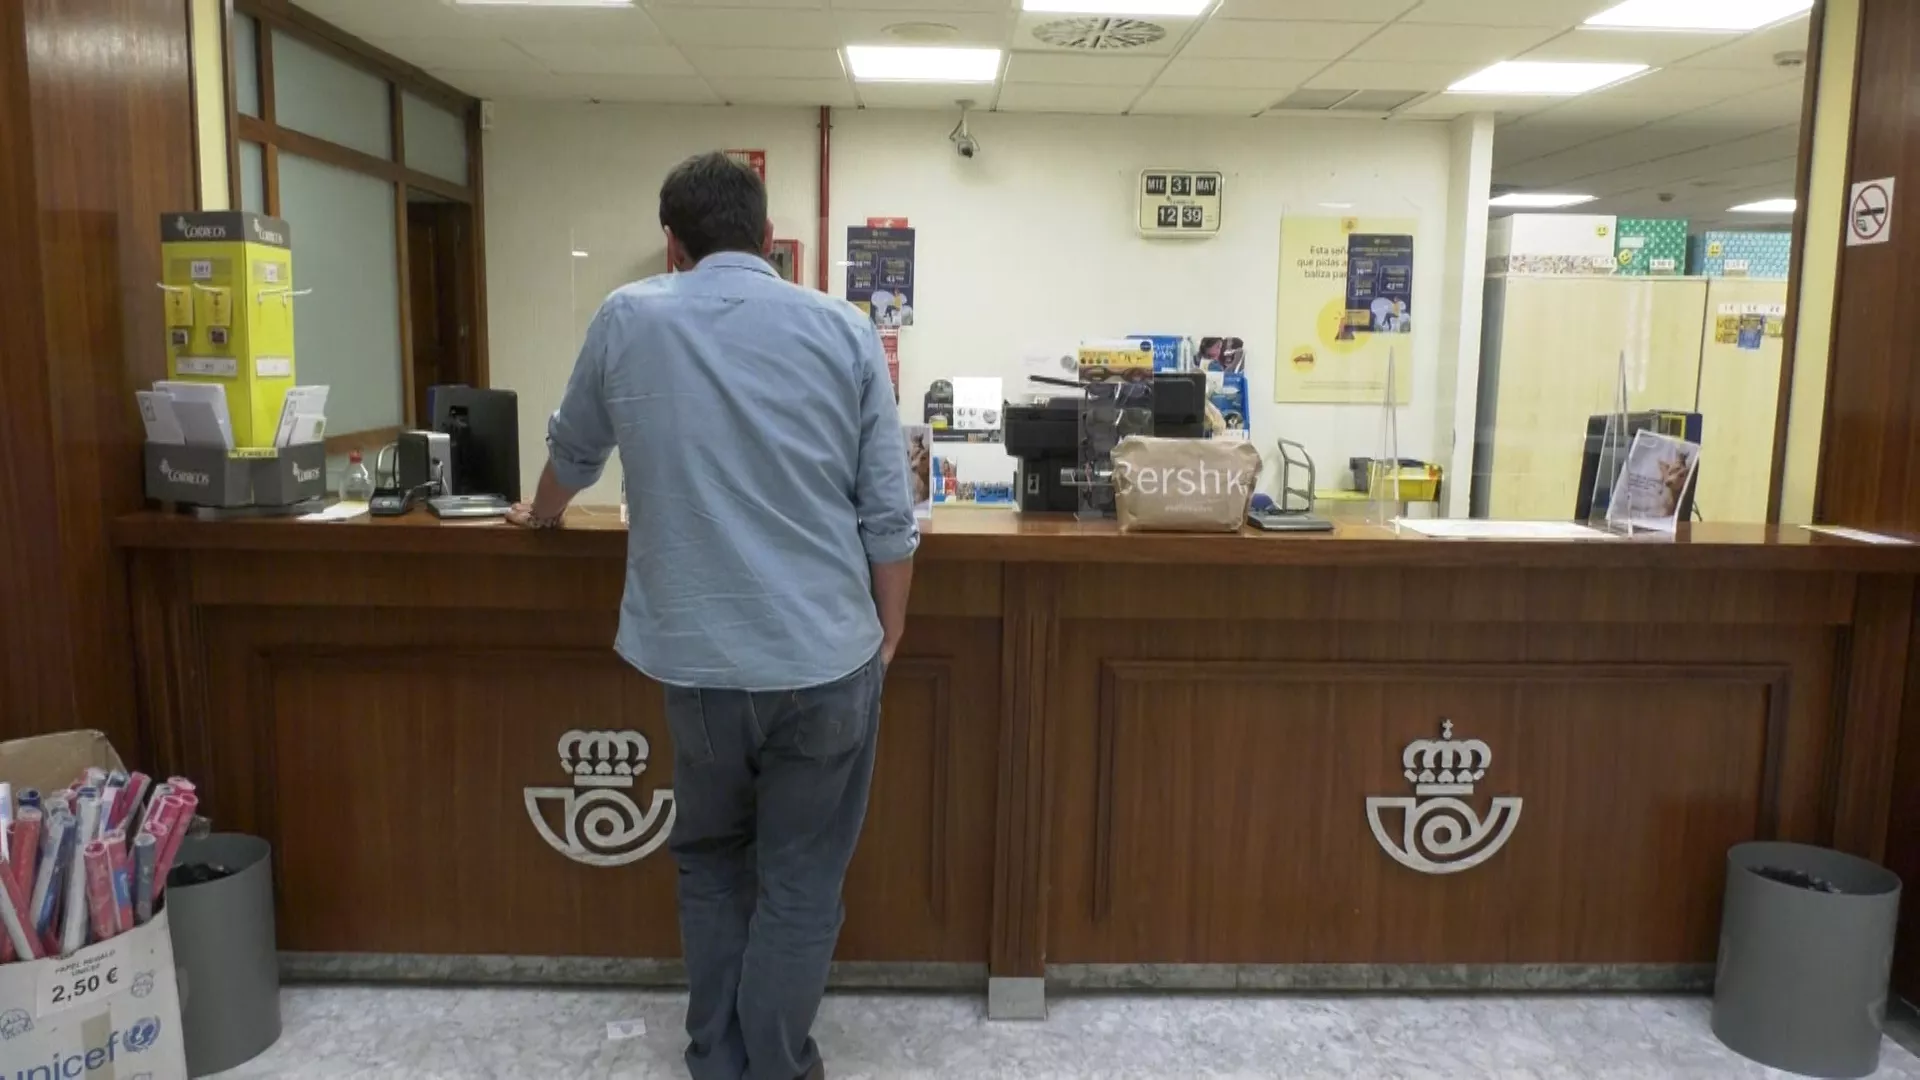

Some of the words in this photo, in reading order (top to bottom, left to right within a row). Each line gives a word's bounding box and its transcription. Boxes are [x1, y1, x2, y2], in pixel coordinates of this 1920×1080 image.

[1172, 178, 1190, 192] 31
[1196, 180, 1214, 191] MAY
[1159, 207, 1176, 222] 12
[1183, 207, 1202, 222] 39
[1310, 245, 1329, 255] Esta
[1297, 259, 1314, 269] que
[1315, 258, 1340, 268] pidas
[1304, 269, 1331, 278] baliza
[52, 974, 100, 1004] 2,50
[106, 965, 118, 985] €
